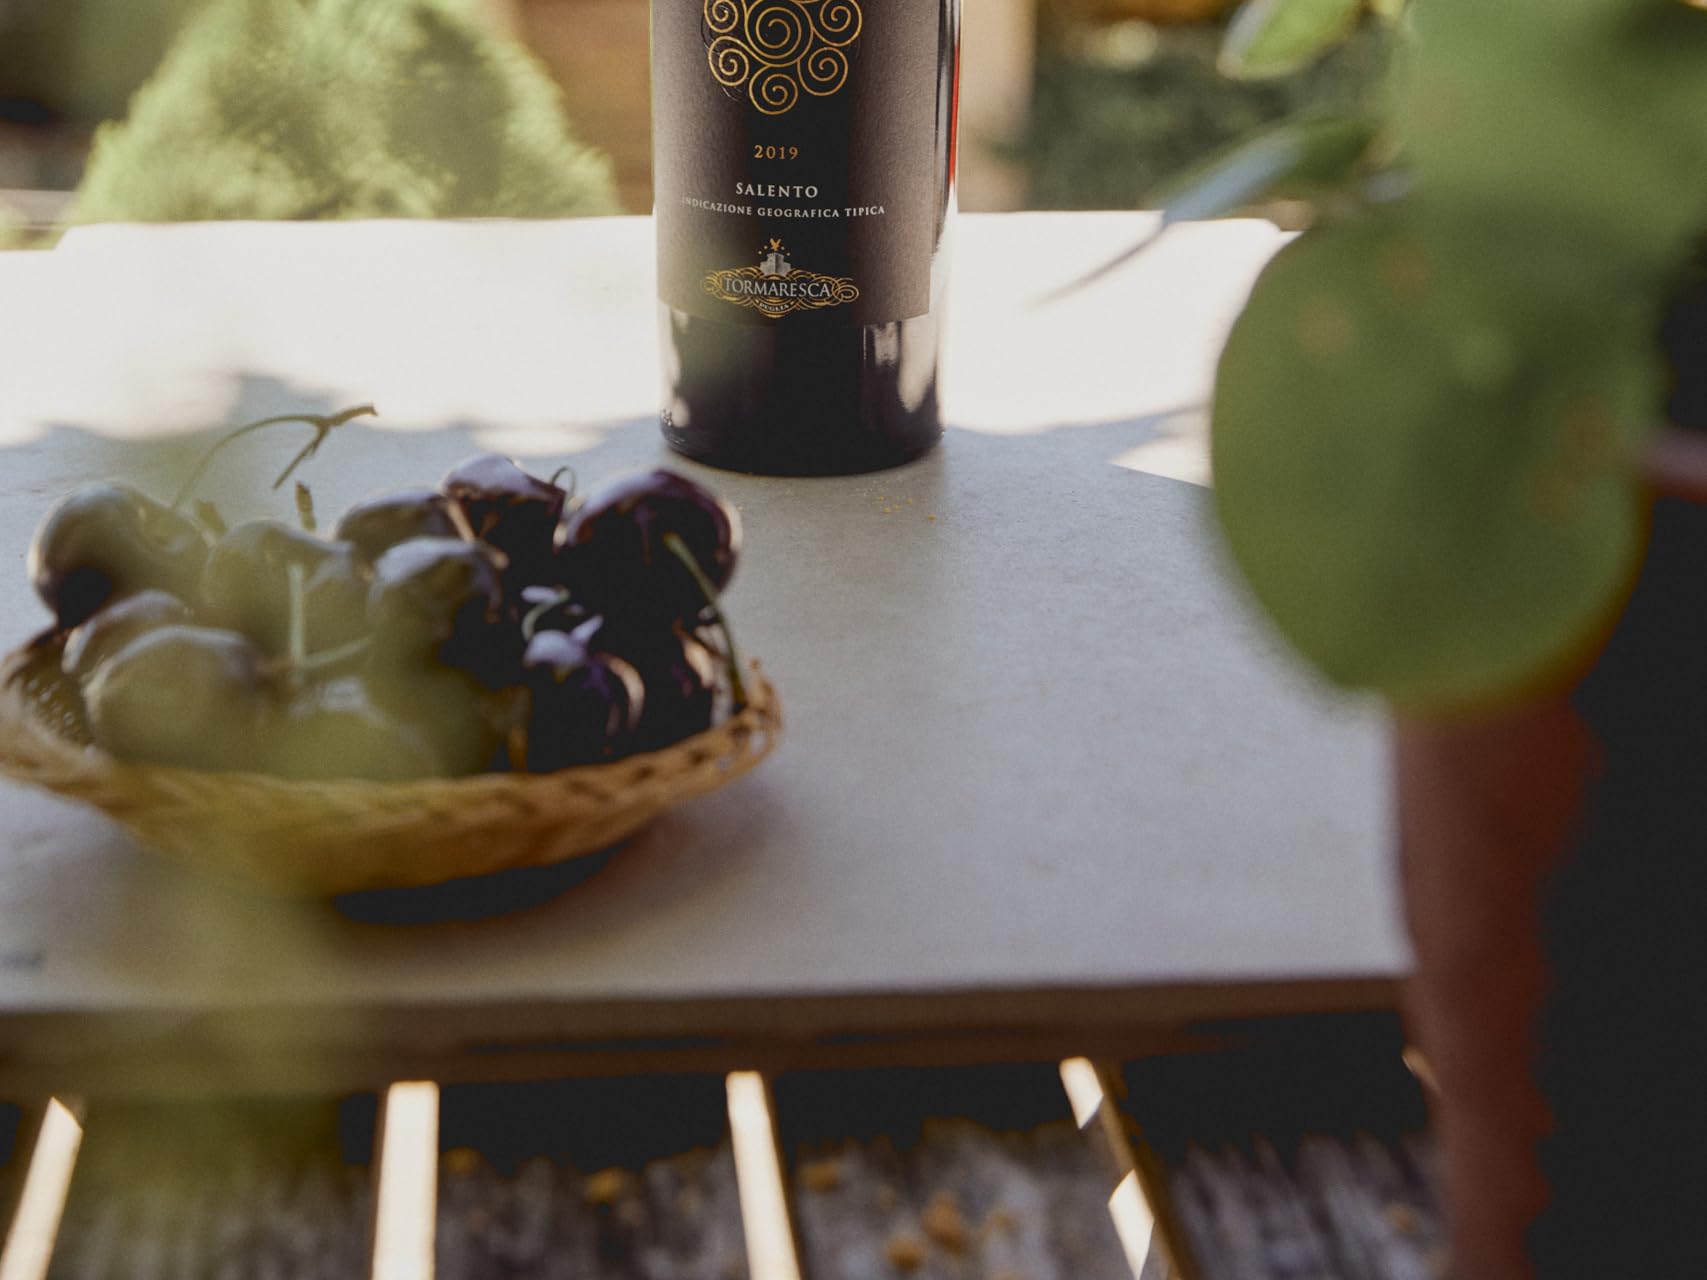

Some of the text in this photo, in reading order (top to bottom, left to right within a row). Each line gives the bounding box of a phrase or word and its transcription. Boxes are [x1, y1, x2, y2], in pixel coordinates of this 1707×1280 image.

[753, 144, 799, 160] 2019
[735, 182, 818, 199] SALENTO
[681, 196, 885, 218] INDICAZIONE GEOGRAFICA TIPICA
[724, 277, 832, 298] TORMARESCA
[758, 302, 790, 313] PUGLIA
